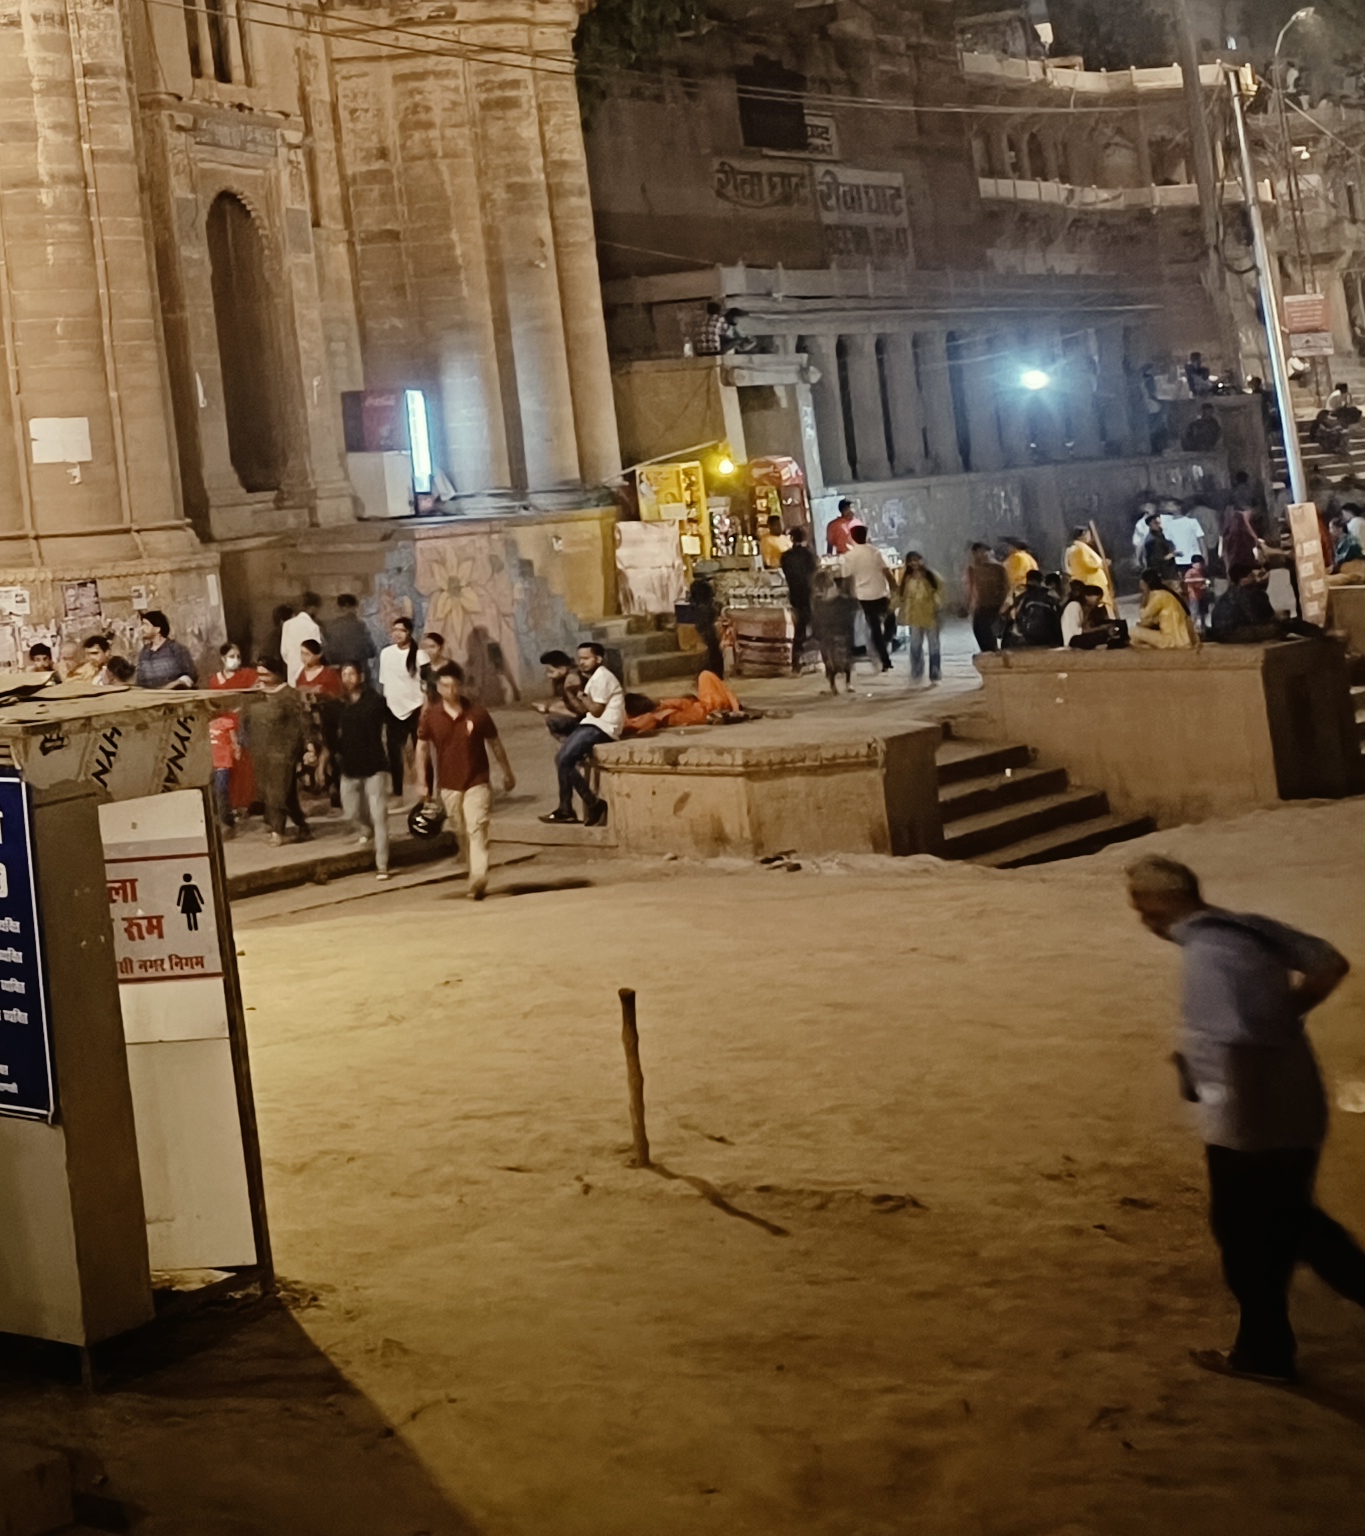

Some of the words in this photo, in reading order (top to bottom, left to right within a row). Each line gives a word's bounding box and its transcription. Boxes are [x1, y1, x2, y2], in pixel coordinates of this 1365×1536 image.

[121, 914, 164, 942] रूम
[138, 957, 166, 972] नगर
[168, 953, 205, 971] निगम
